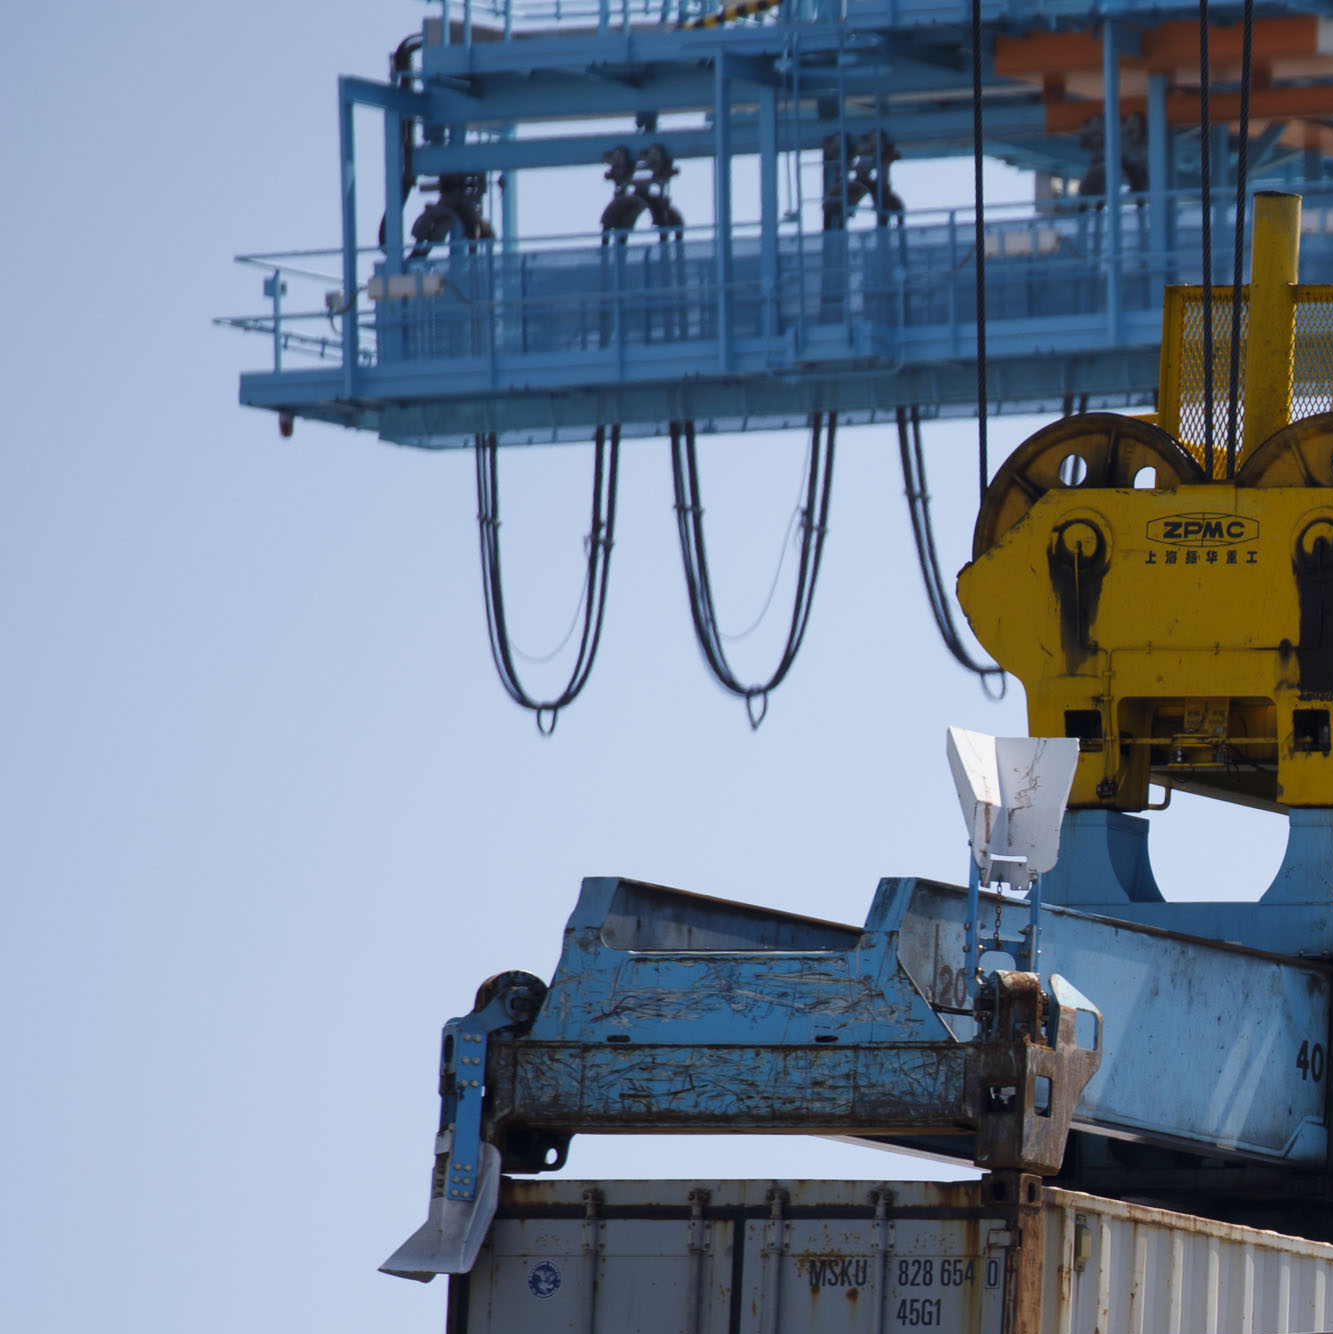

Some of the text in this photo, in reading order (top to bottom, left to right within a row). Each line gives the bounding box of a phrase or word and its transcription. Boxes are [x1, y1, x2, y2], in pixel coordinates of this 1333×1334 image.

[1163, 521, 1245, 539] ZPMC
[1296, 1040, 1324, 1083] 40
[809, 1259, 975, 1287] MSKU 828 654
[896, 1298, 941, 1326] 45G1
